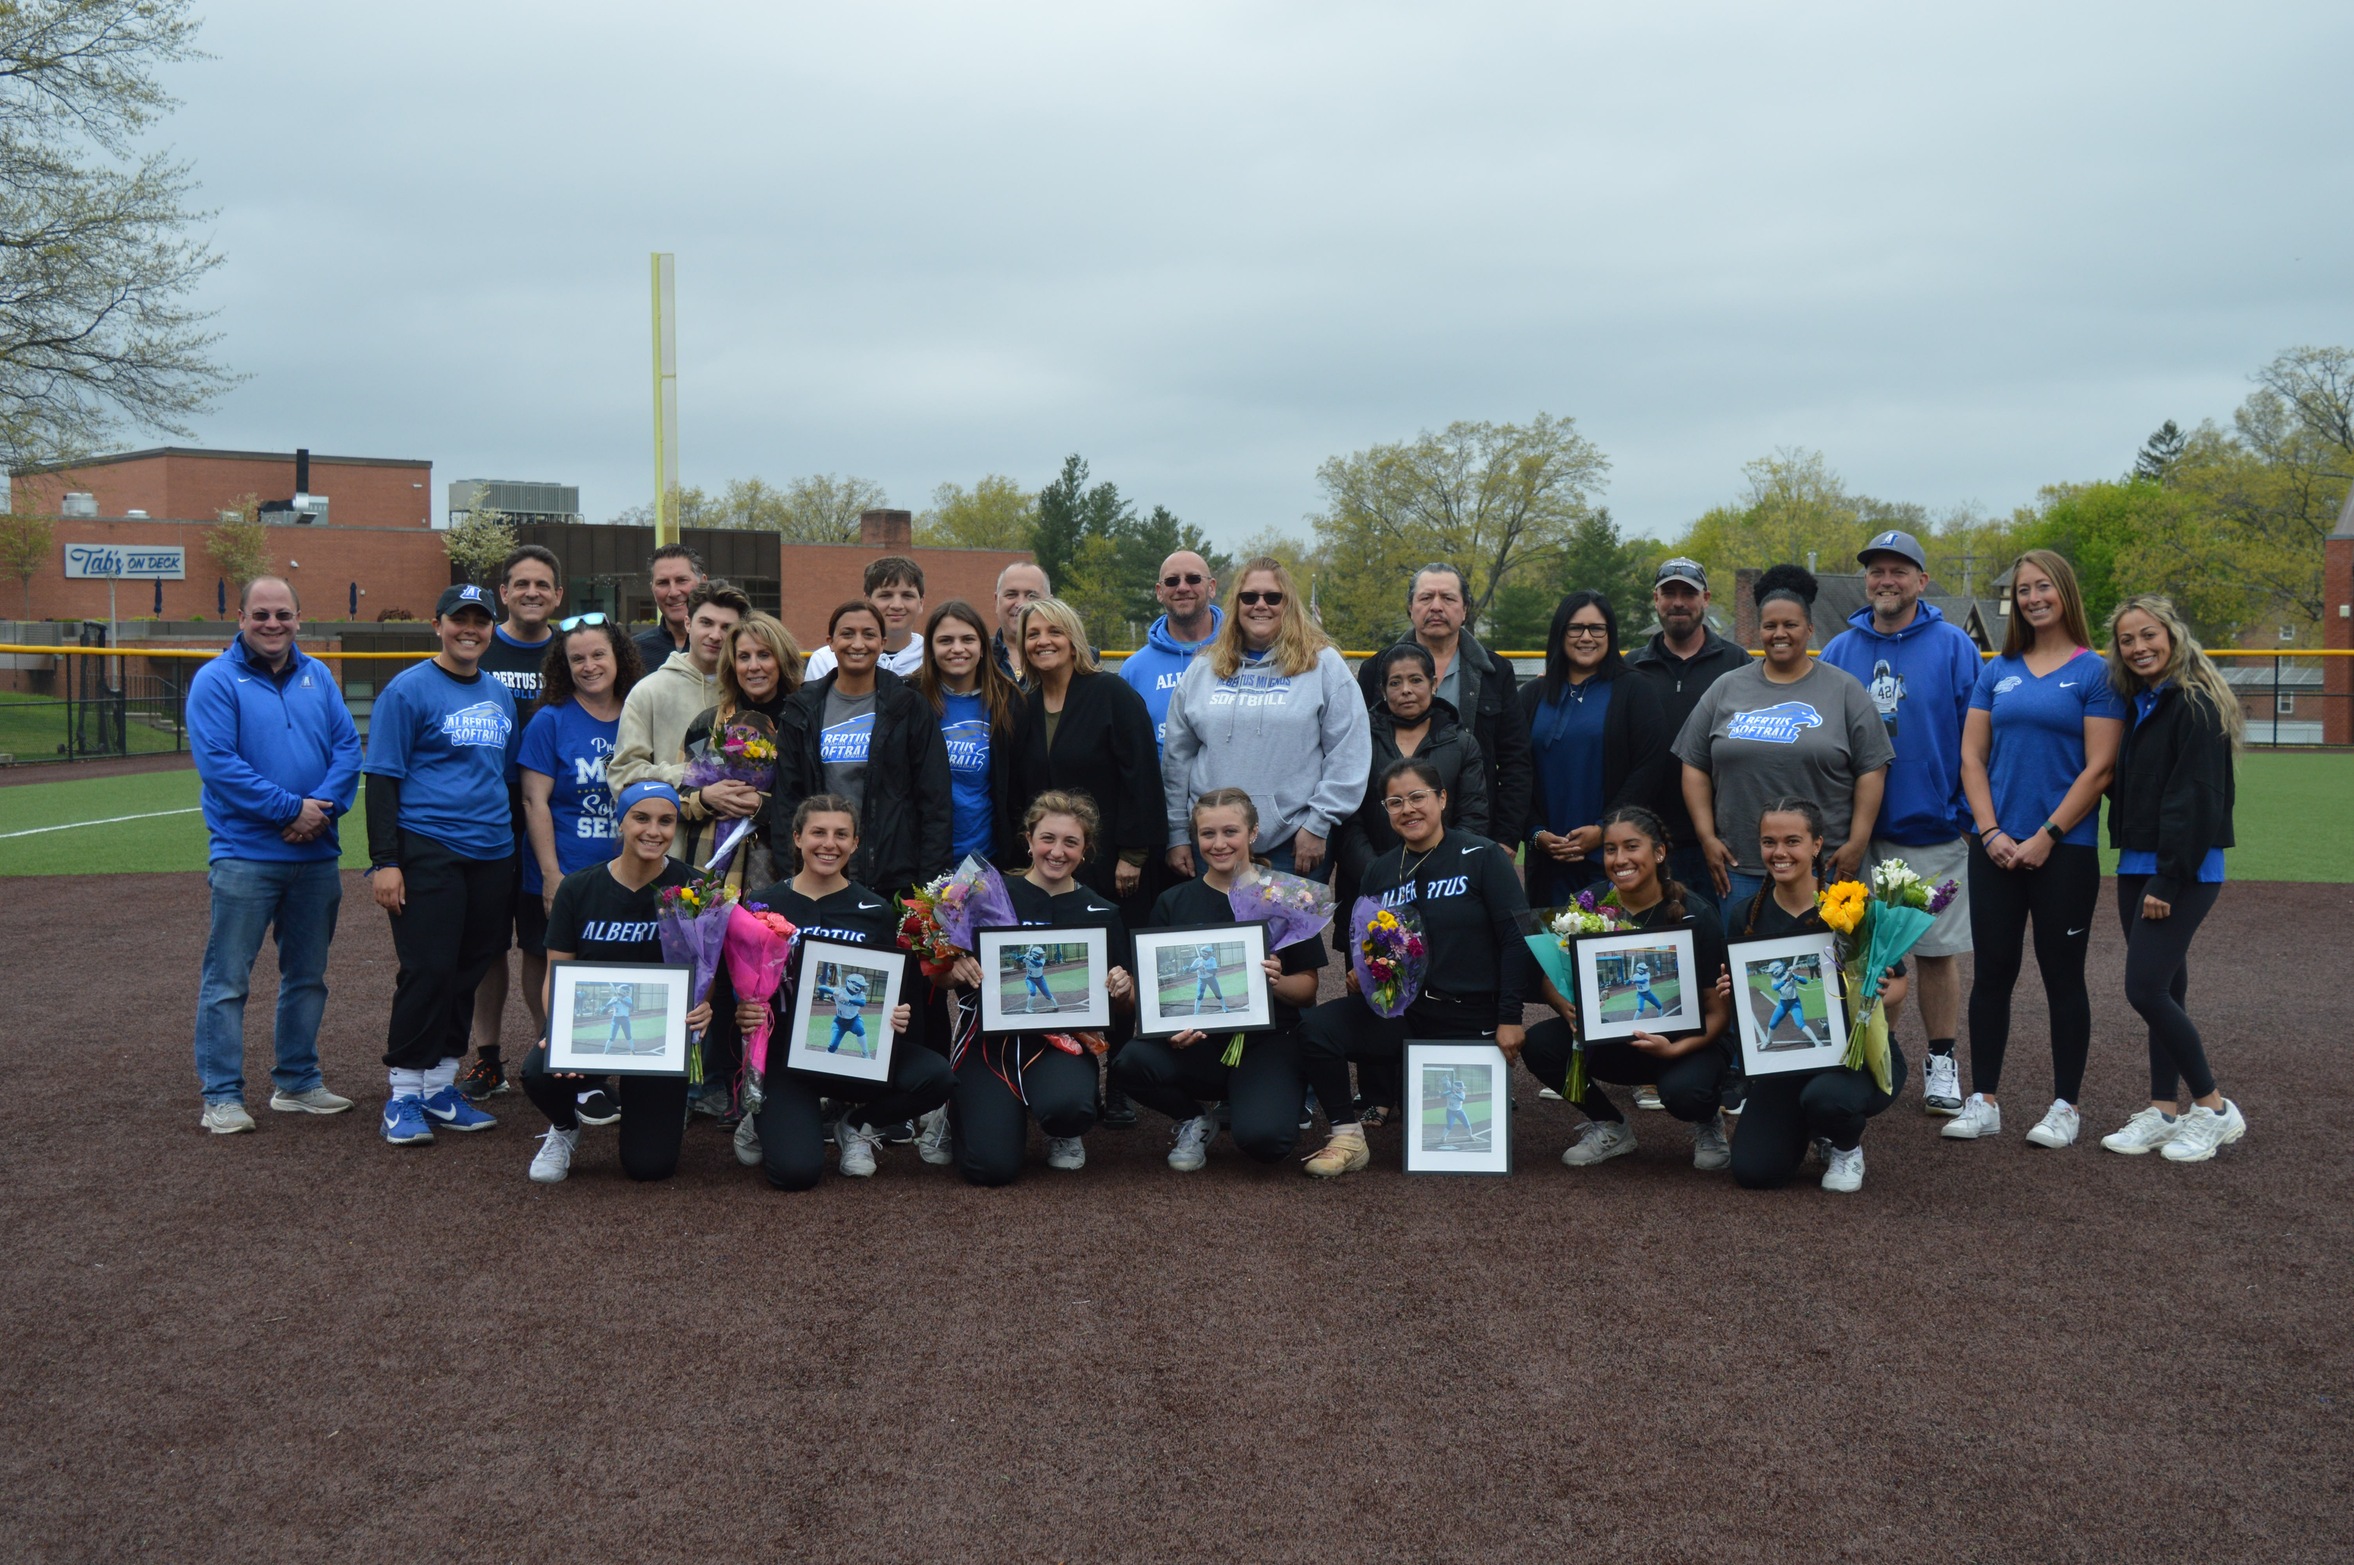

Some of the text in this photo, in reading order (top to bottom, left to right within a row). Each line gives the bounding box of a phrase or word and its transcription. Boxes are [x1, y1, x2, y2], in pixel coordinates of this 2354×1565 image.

[71, 548, 180, 575] Tab's ON DECK
[487, 671, 537, 690] BERTUS
[1216, 674, 1291, 688] ALBETUS MGNUS
[1878, 686, 1892, 700] 42
[1209, 694, 1287, 707] SOFTBALL
[447, 716, 498, 730] ALBERTUS
[1732, 714, 1793, 728] ALBERTUS
[455, 729, 503, 744] SOFTBALL
[824, 733, 871, 745] BERTUS
[1730, 725, 1794, 740] SOFTBALL
[821, 745, 868, 759] OFTBAL
[946, 740, 976, 755] RTUS
[949, 754, 979, 768] BALL
[582, 921, 660, 942] ALBERT
